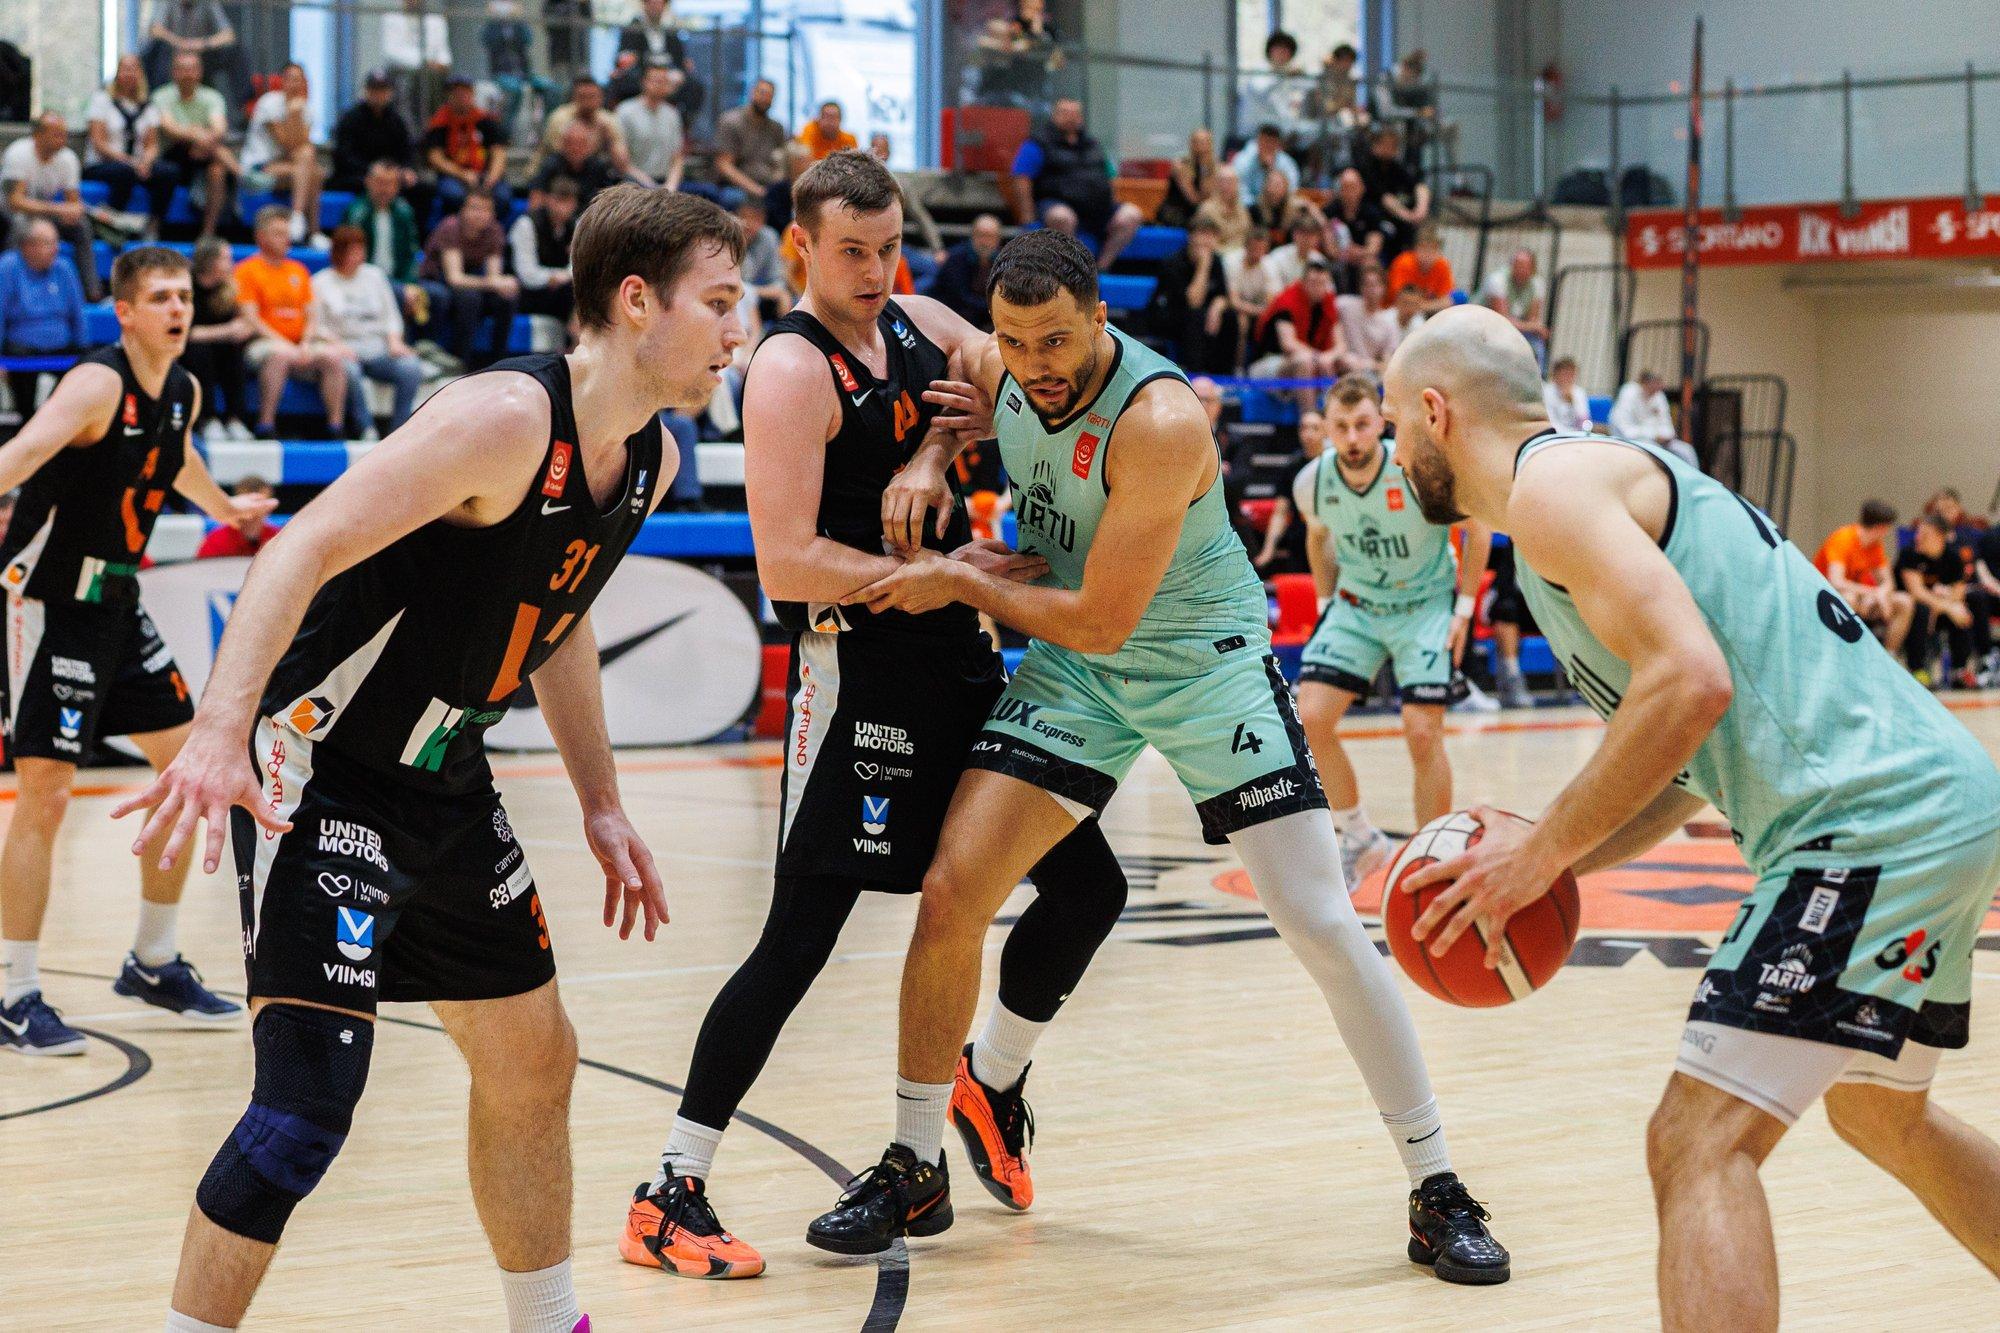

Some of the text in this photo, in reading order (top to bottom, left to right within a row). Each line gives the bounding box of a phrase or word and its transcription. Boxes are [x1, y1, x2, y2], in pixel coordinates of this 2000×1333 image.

[549, 538, 601, 594] 31
[796, 684, 816, 767] SPORTLAND
[855, 721, 908, 741] UNITED
[1031, 719, 1087, 748] Express
[1231, 722, 1264, 755] 4
[854, 734, 915, 755] MOTORS
[264, 740, 286, 841] SPORTLD
[320, 818, 382, 850] UNITED
[853, 838, 891, 855] VIIMSI
[318, 836, 389, 872] MOTORS
[322, 963, 376, 988] VIIMSI
[1758, 963, 1817, 994] TARTU
